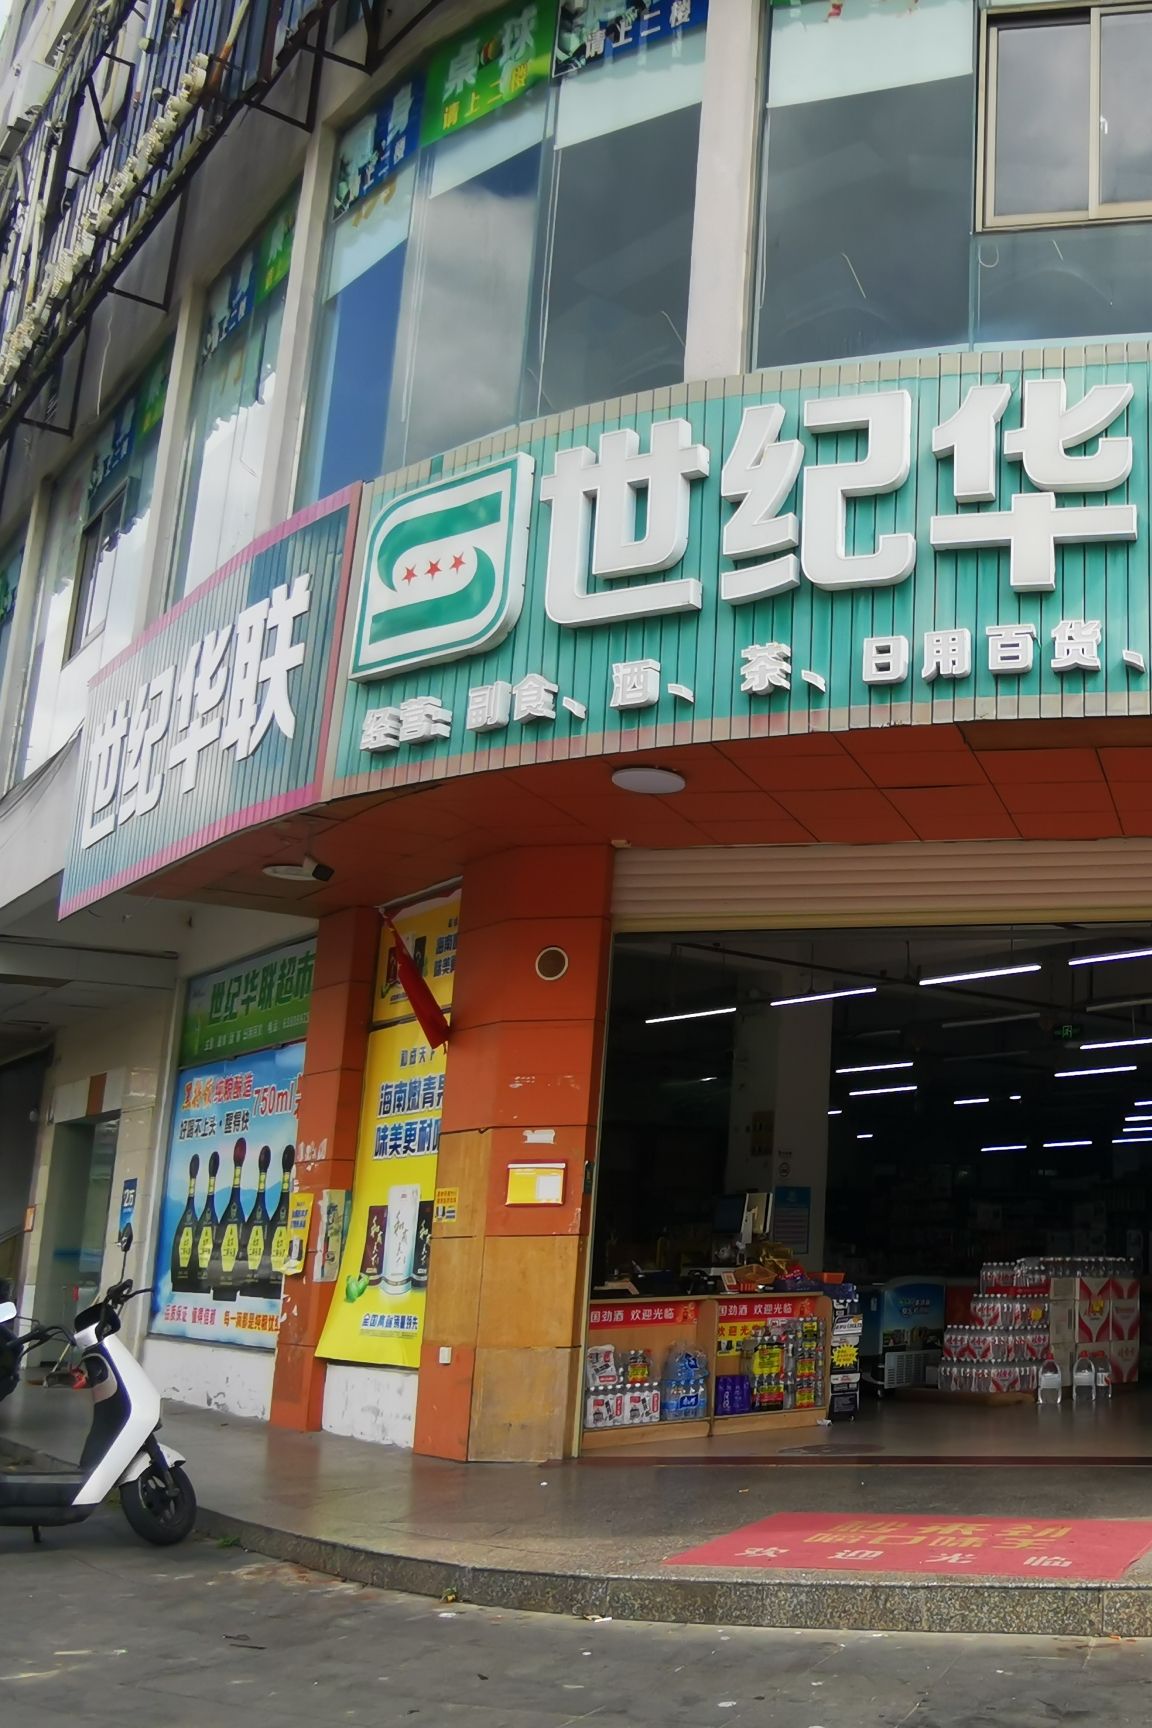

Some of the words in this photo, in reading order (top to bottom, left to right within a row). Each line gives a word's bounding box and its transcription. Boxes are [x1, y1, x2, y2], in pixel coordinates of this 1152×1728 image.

[82, 572, 311, 849] 世纪华联
[630, 1307, 675, 1321] 欢迎光临
[754, 1303, 793, 1316] 欢迎光临
[735, 1547, 1073, 1568] 欢迎光临
